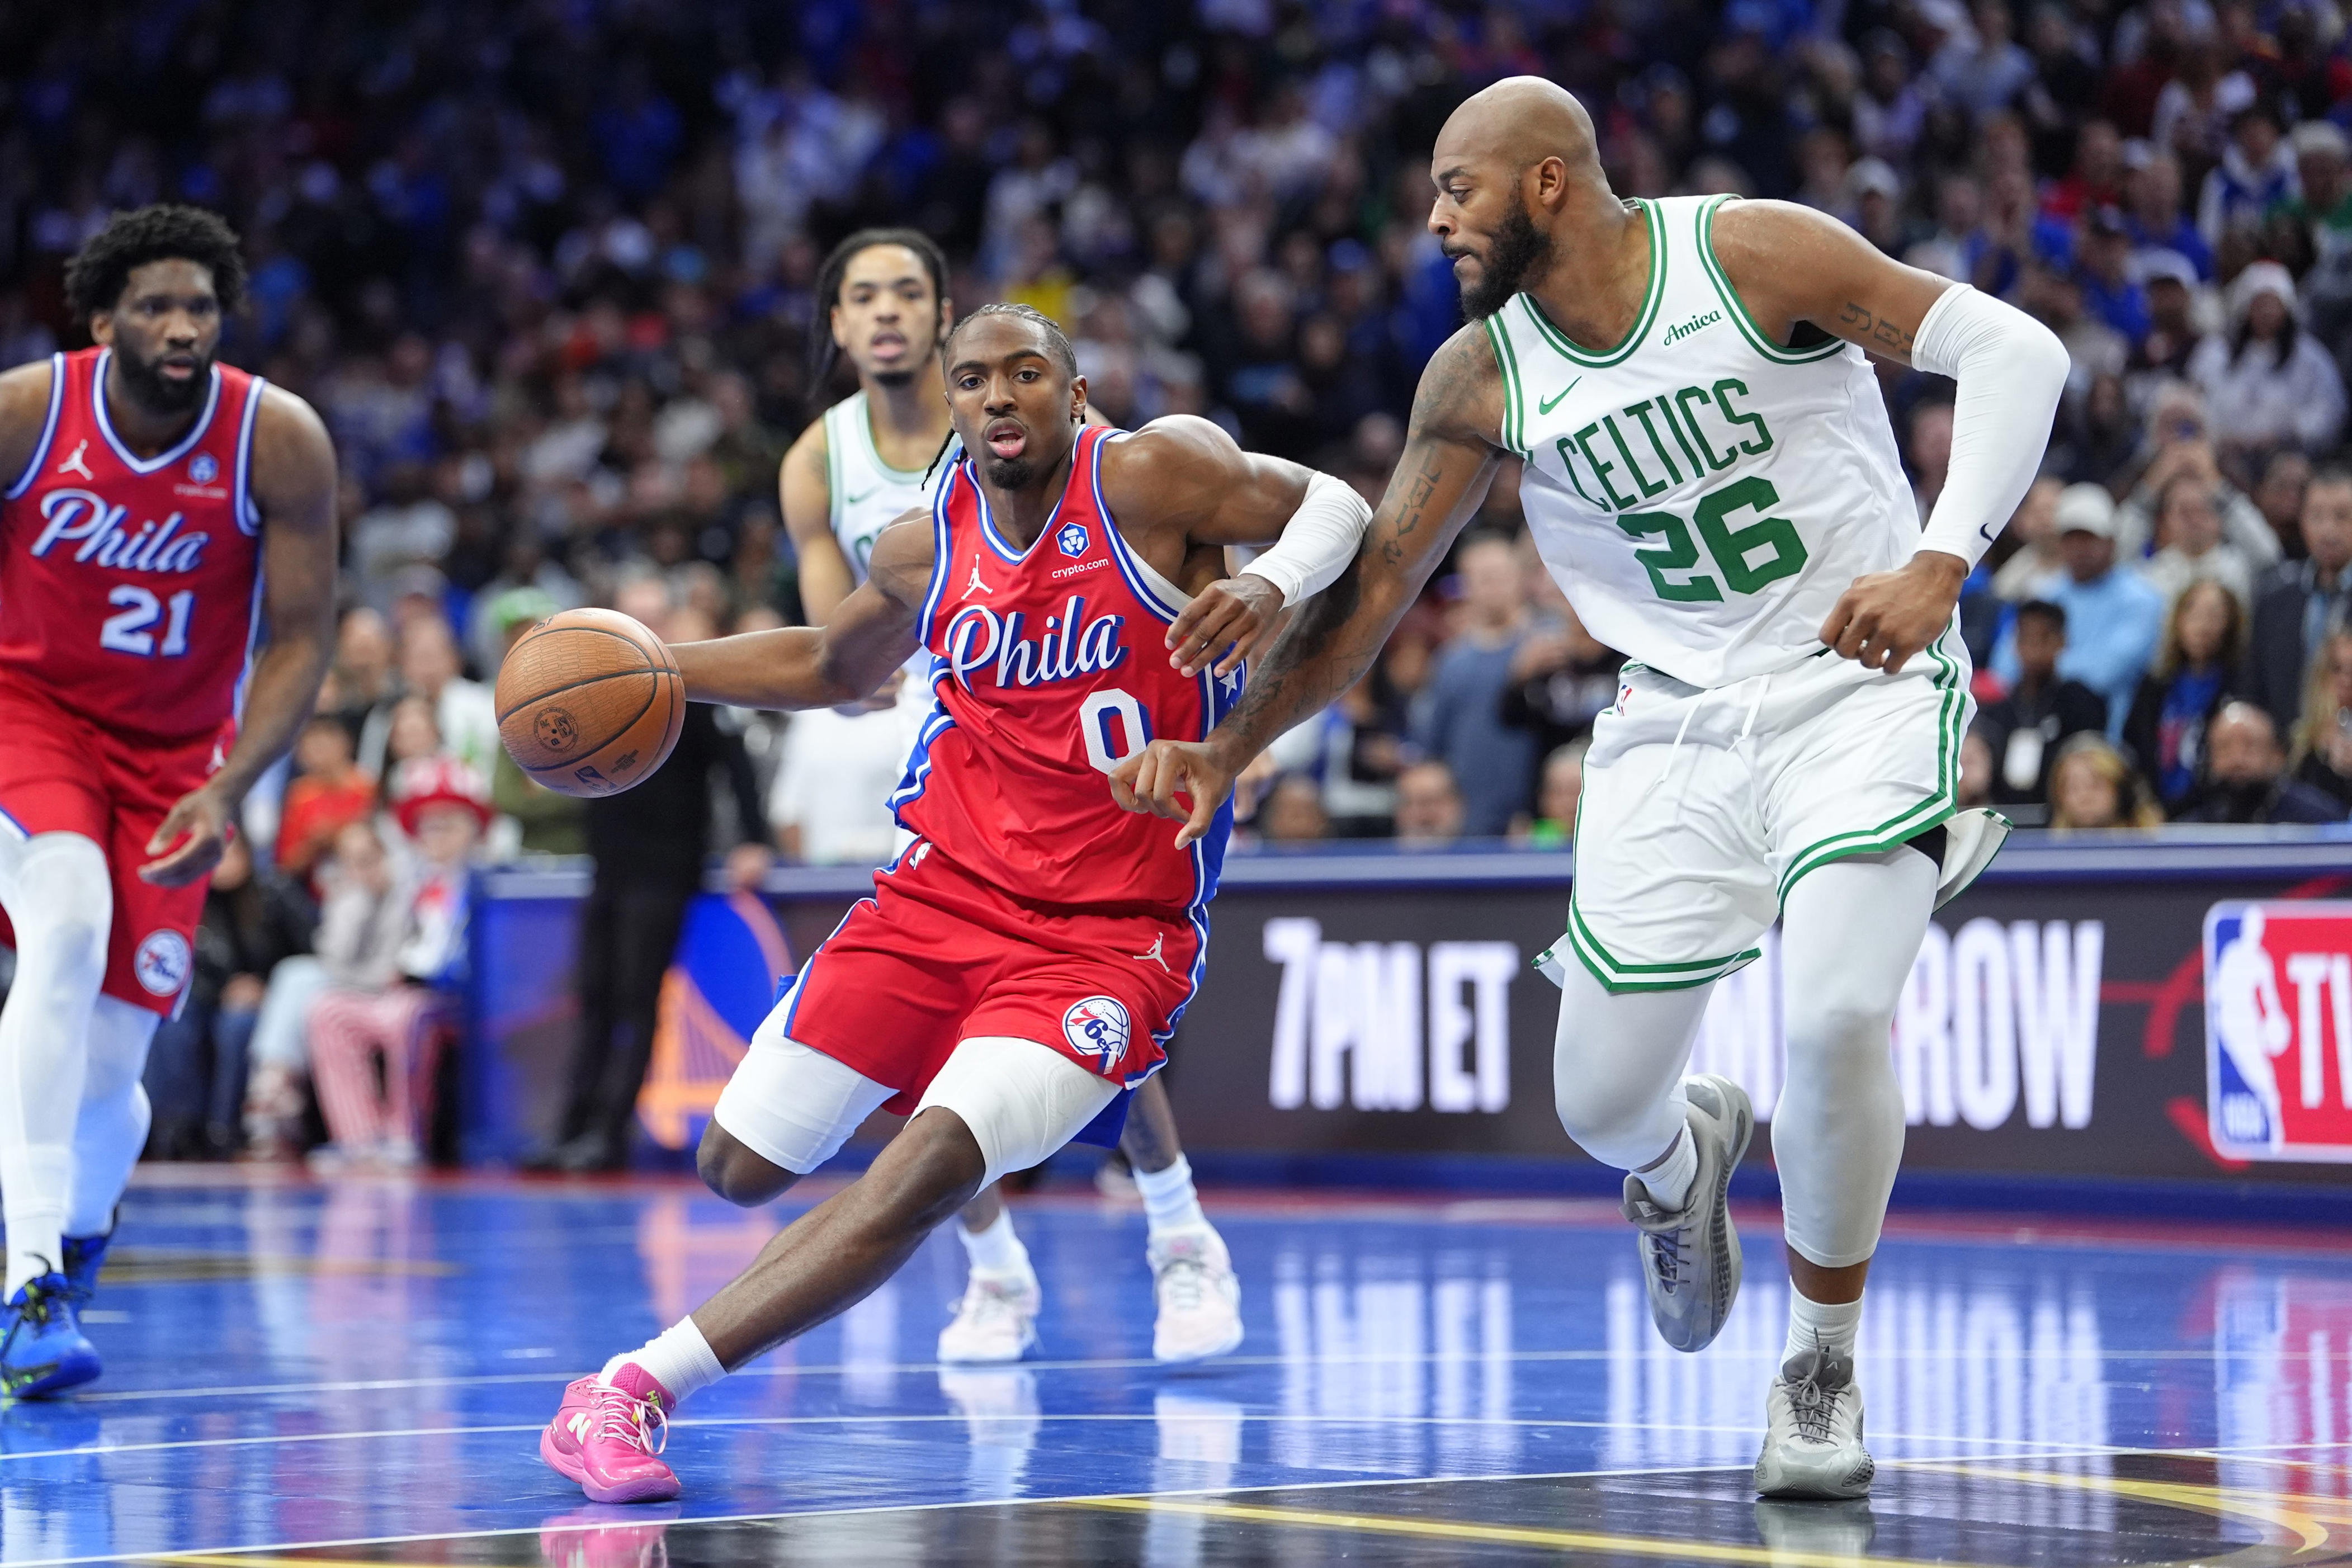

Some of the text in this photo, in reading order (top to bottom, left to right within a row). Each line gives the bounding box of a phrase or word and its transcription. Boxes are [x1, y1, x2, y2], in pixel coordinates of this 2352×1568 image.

[1663, 309, 1722, 346] Amica
[1556, 377, 1774, 513] CELTICS
[29, 488, 210, 573] Phila
[1051, 558, 1109, 579] crypto.com
[1615, 476, 1808, 603] 26
[99, 584, 194, 658] 21
[944, 595, 1128, 694] Phila
[1079, 688, 1154, 776] 0
[1069, 1007, 1113, 1054] 76er
[1263, 917, 1424, 1112] 7PM
[1427, 940, 1520, 1113] ET
